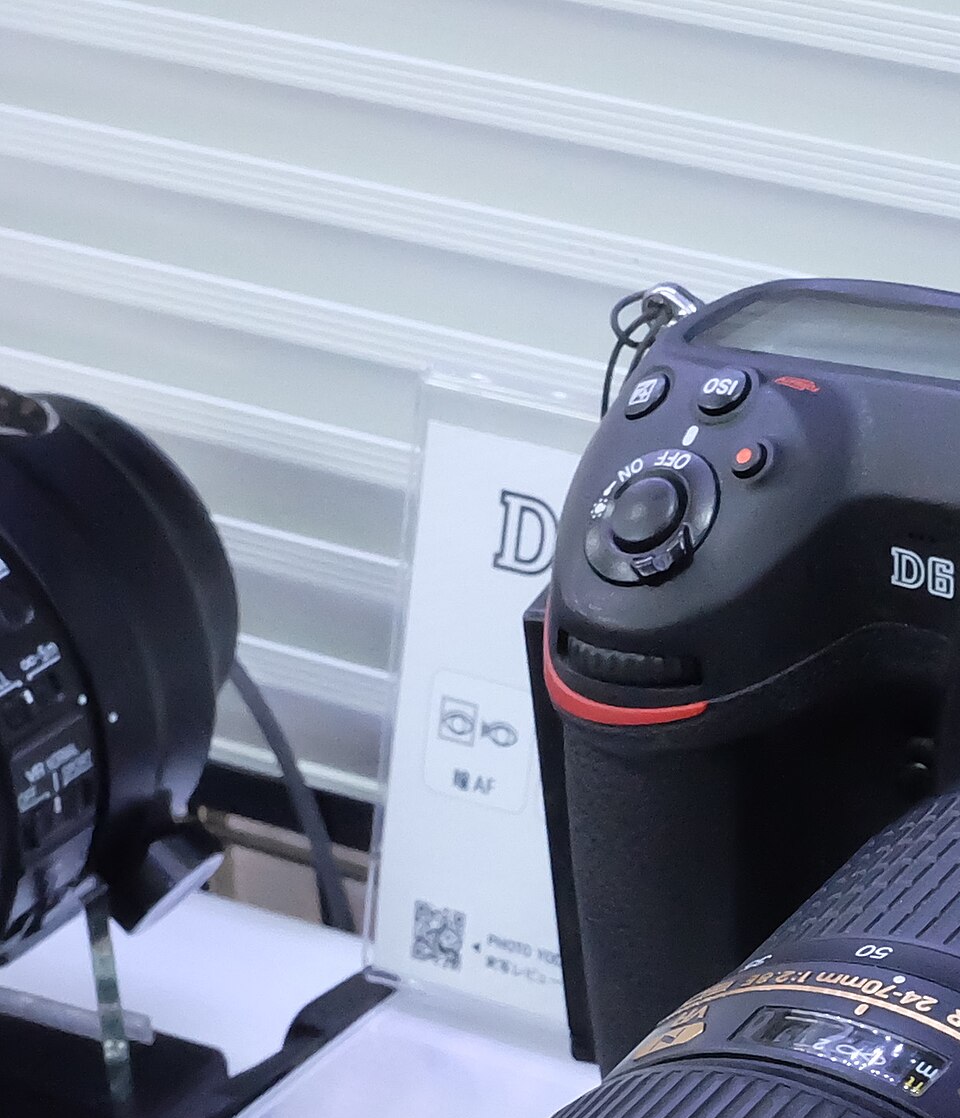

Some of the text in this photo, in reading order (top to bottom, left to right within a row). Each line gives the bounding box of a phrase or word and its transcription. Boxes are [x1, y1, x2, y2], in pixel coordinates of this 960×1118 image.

[703, 377, 738, 396] ISO
[617, 458, 644, 483] ON
[654, 451, 692, 470] OFF
[890, 546, 955, 599] D6
[855, 944, 893, 960] 50
[815, 970, 938, 1012] 24-70mm
